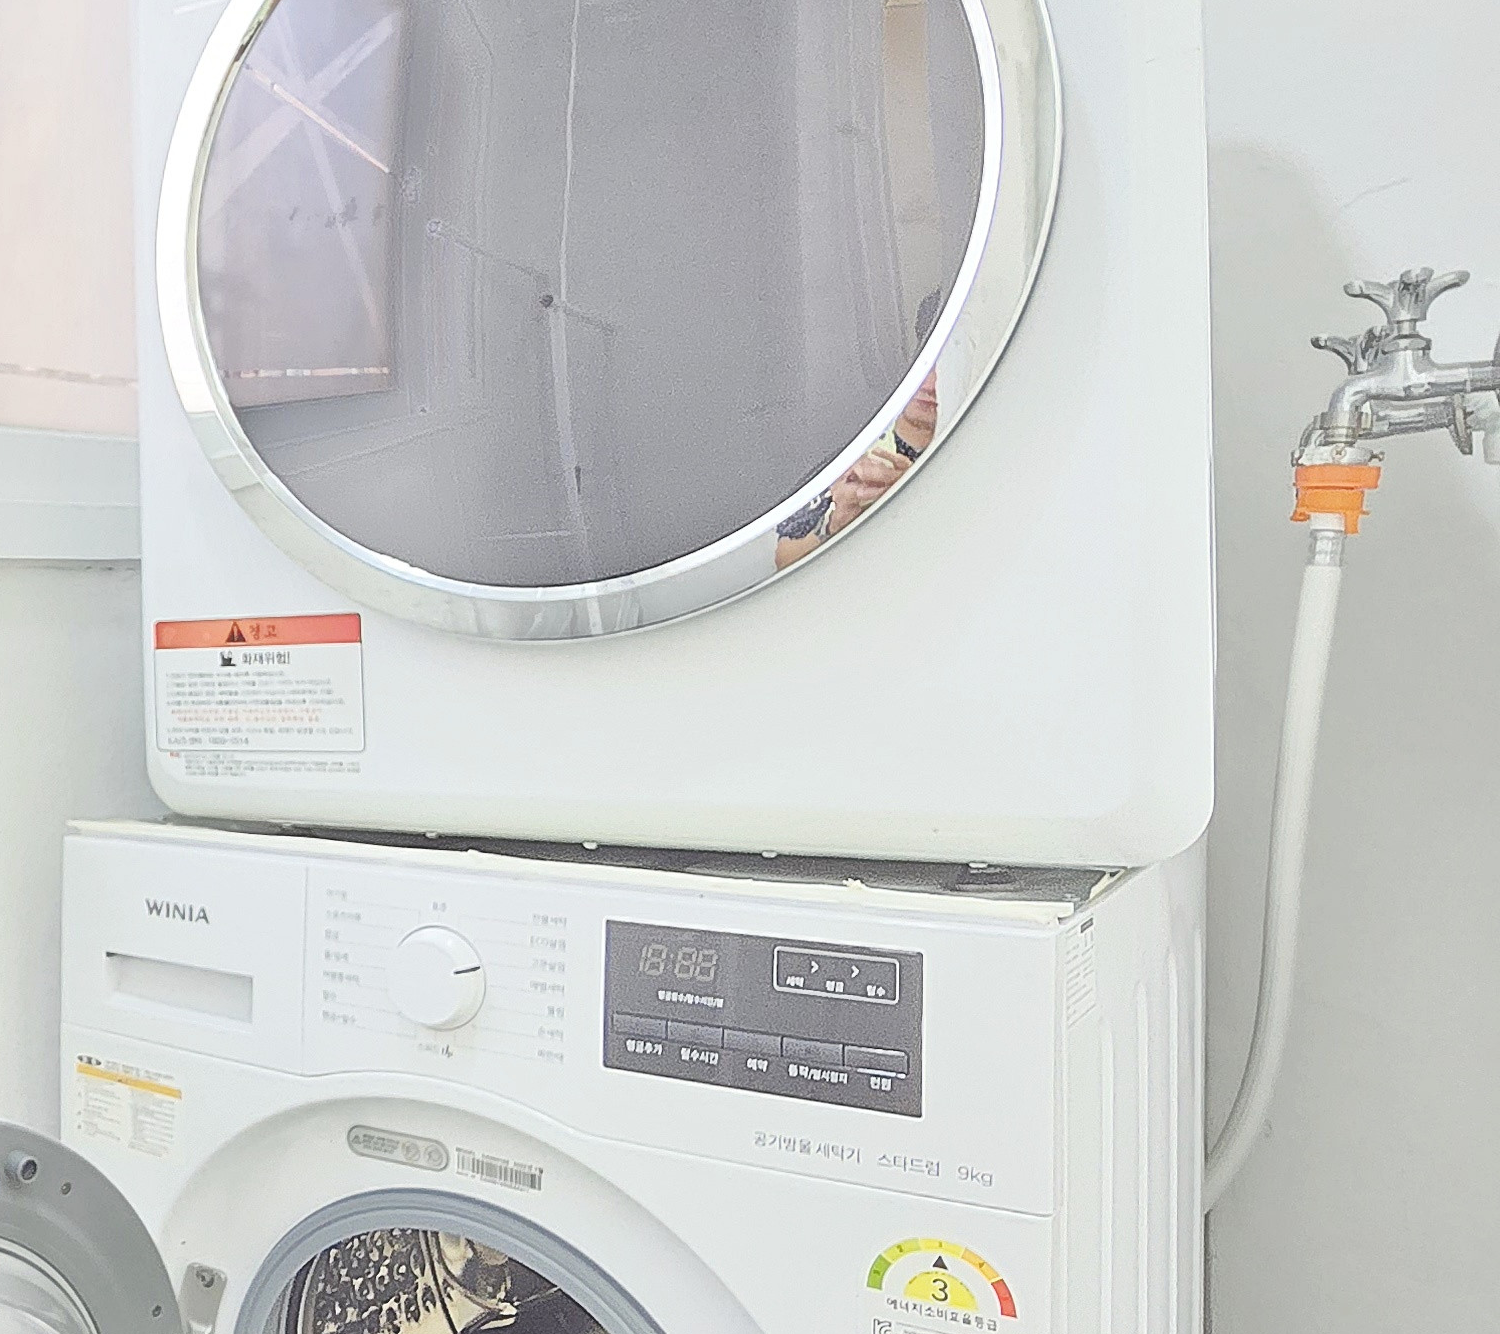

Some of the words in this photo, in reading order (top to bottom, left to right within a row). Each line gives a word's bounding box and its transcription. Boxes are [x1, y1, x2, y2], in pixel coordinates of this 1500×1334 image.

[249, 623, 278, 640] 경고
[145, 898, 210, 924] WINIA
[815, 1142, 862, 1165] 세탁기
[957, 1165, 994, 1188] 9kg
[931, 1278, 949, 1302] 3
